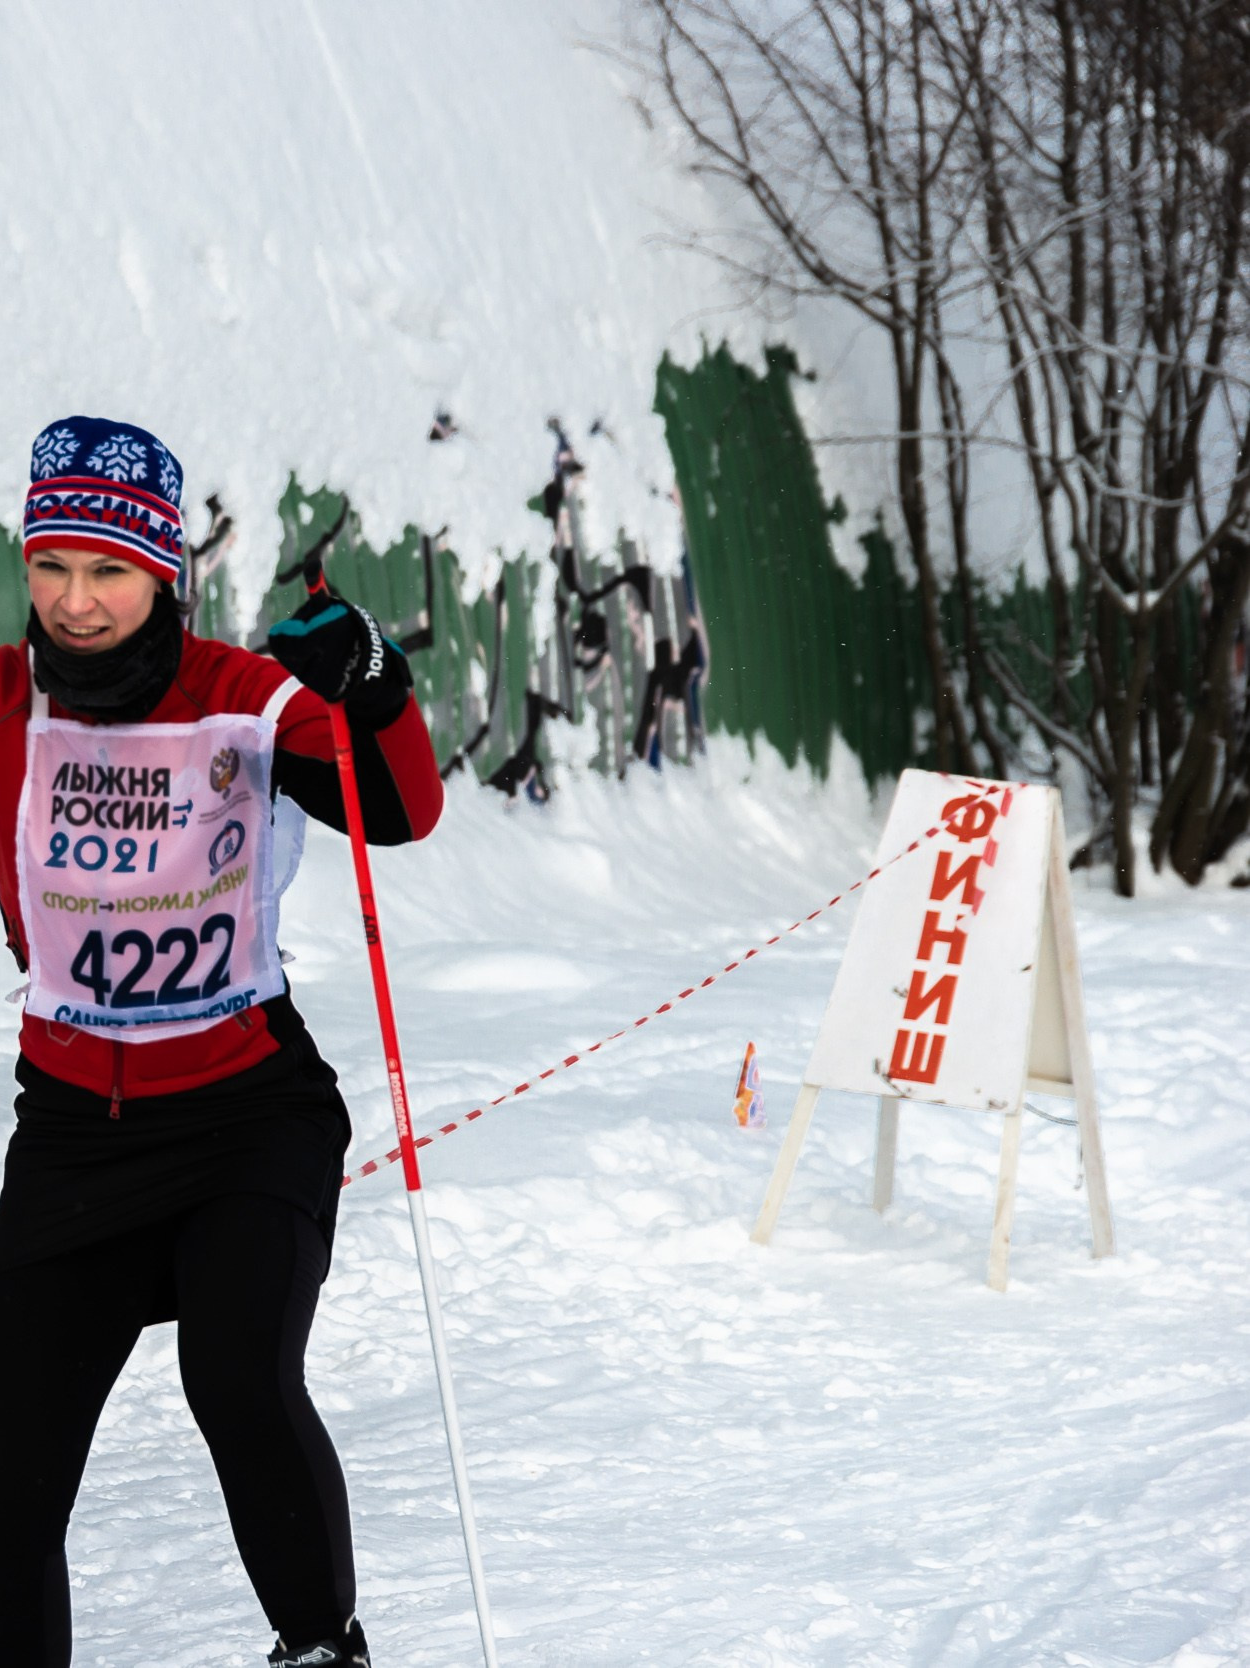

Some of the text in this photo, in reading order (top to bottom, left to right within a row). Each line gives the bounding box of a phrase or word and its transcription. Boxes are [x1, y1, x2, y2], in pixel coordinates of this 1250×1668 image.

[353, 604, 384, 681] SSIGNOL
[52, 762, 171, 797] ЛЫЖНЯ
[50, 795, 171, 831] РОССИИ
[43, 832, 159, 873] 2021
[42, 863, 249, 915] СПОРТ НОРМА ЖИЗНИ
[70, 913, 236, 1009] 4222
[888, 793, 999, 1085] ФИНИШ
